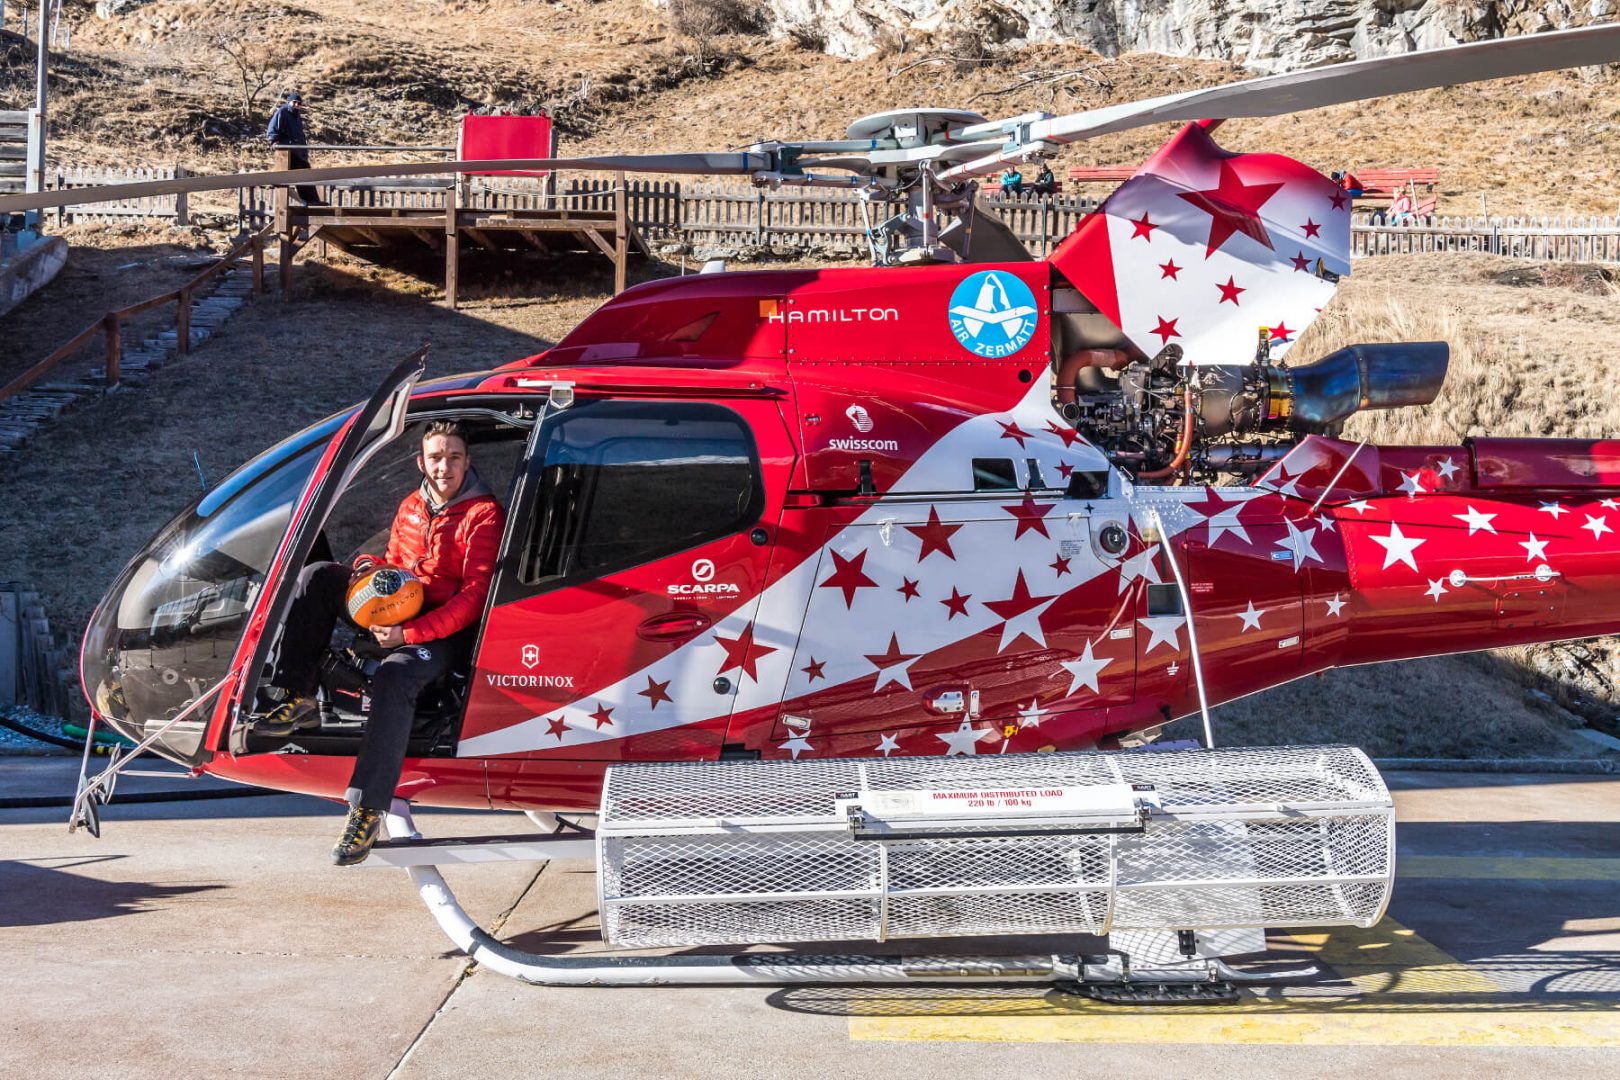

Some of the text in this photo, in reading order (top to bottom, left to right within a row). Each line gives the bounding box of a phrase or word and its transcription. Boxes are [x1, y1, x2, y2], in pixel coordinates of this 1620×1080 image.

[767, 307, 899, 324] HAMILTON
[950, 318, 1036, 356] AIR ZERMATT
[828, 436, 899, 451] swisscom
[667, 583, 741, 594] SCARPA
[486, 674, 575, 688] VICTORINOX
[932, 789, 1063, 800] MAXIMUM DISTRIBUTED LOAD
[987, 799, 995, 807] lb
[1004, 798, 1019, 806] 100
[1021, 798, 1032, 807] kg
